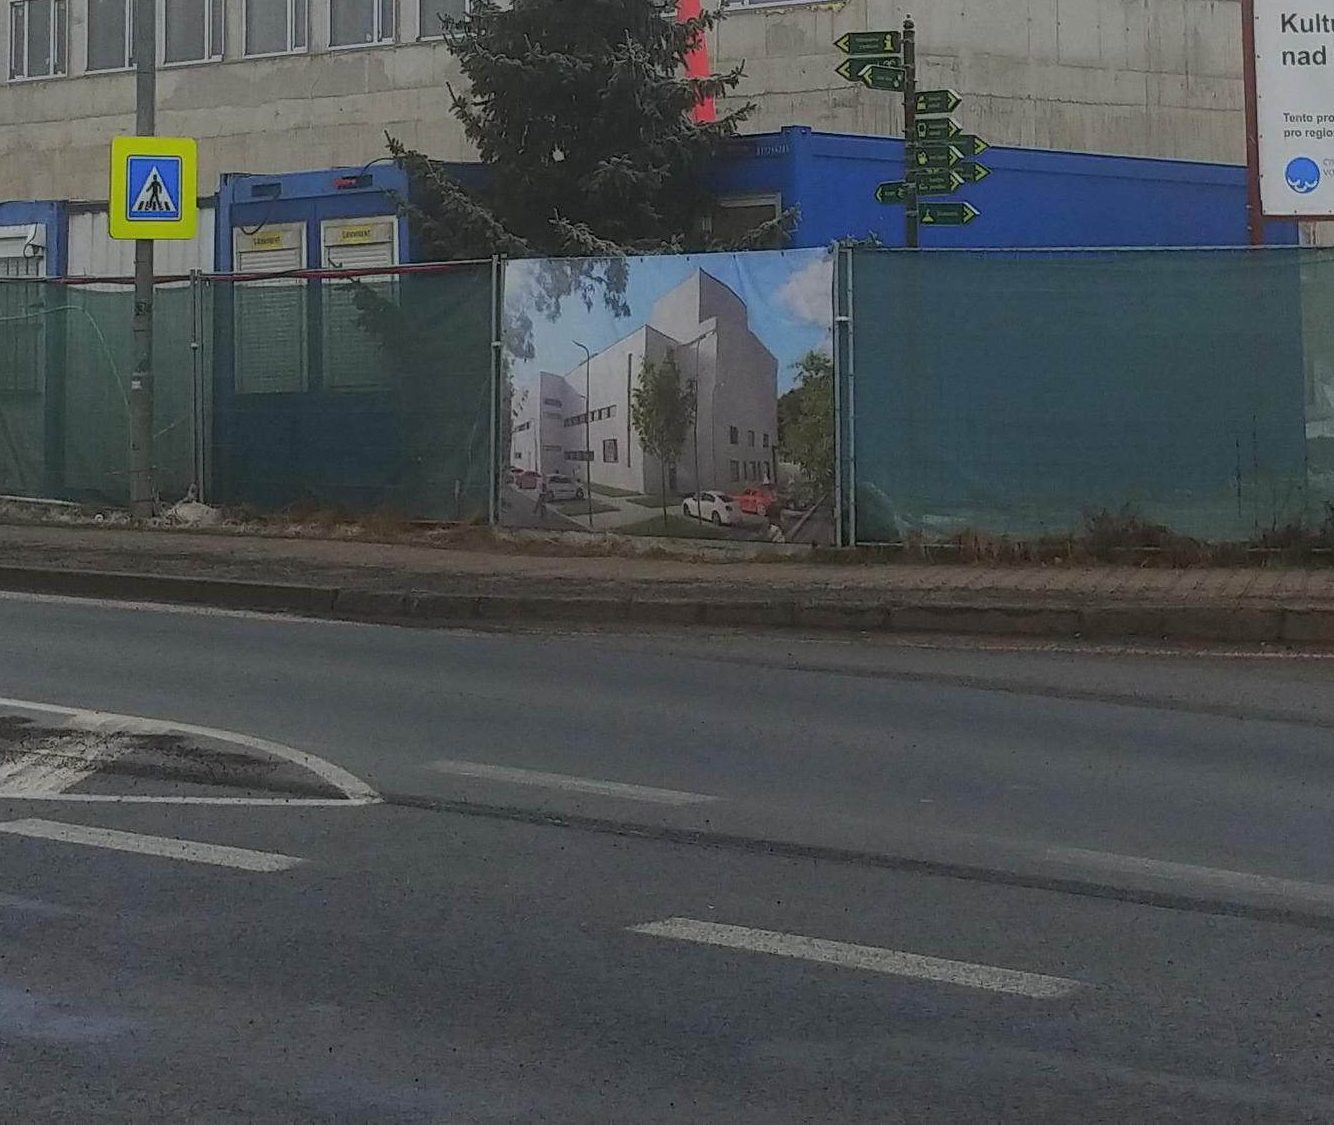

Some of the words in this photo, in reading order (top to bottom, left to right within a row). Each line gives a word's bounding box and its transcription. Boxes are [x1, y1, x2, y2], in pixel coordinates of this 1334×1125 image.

[1282, 45, 1327, 66] nad
[1283, 112, 1313, 123] Tento
[1283, 129, 1302, 139] pro
